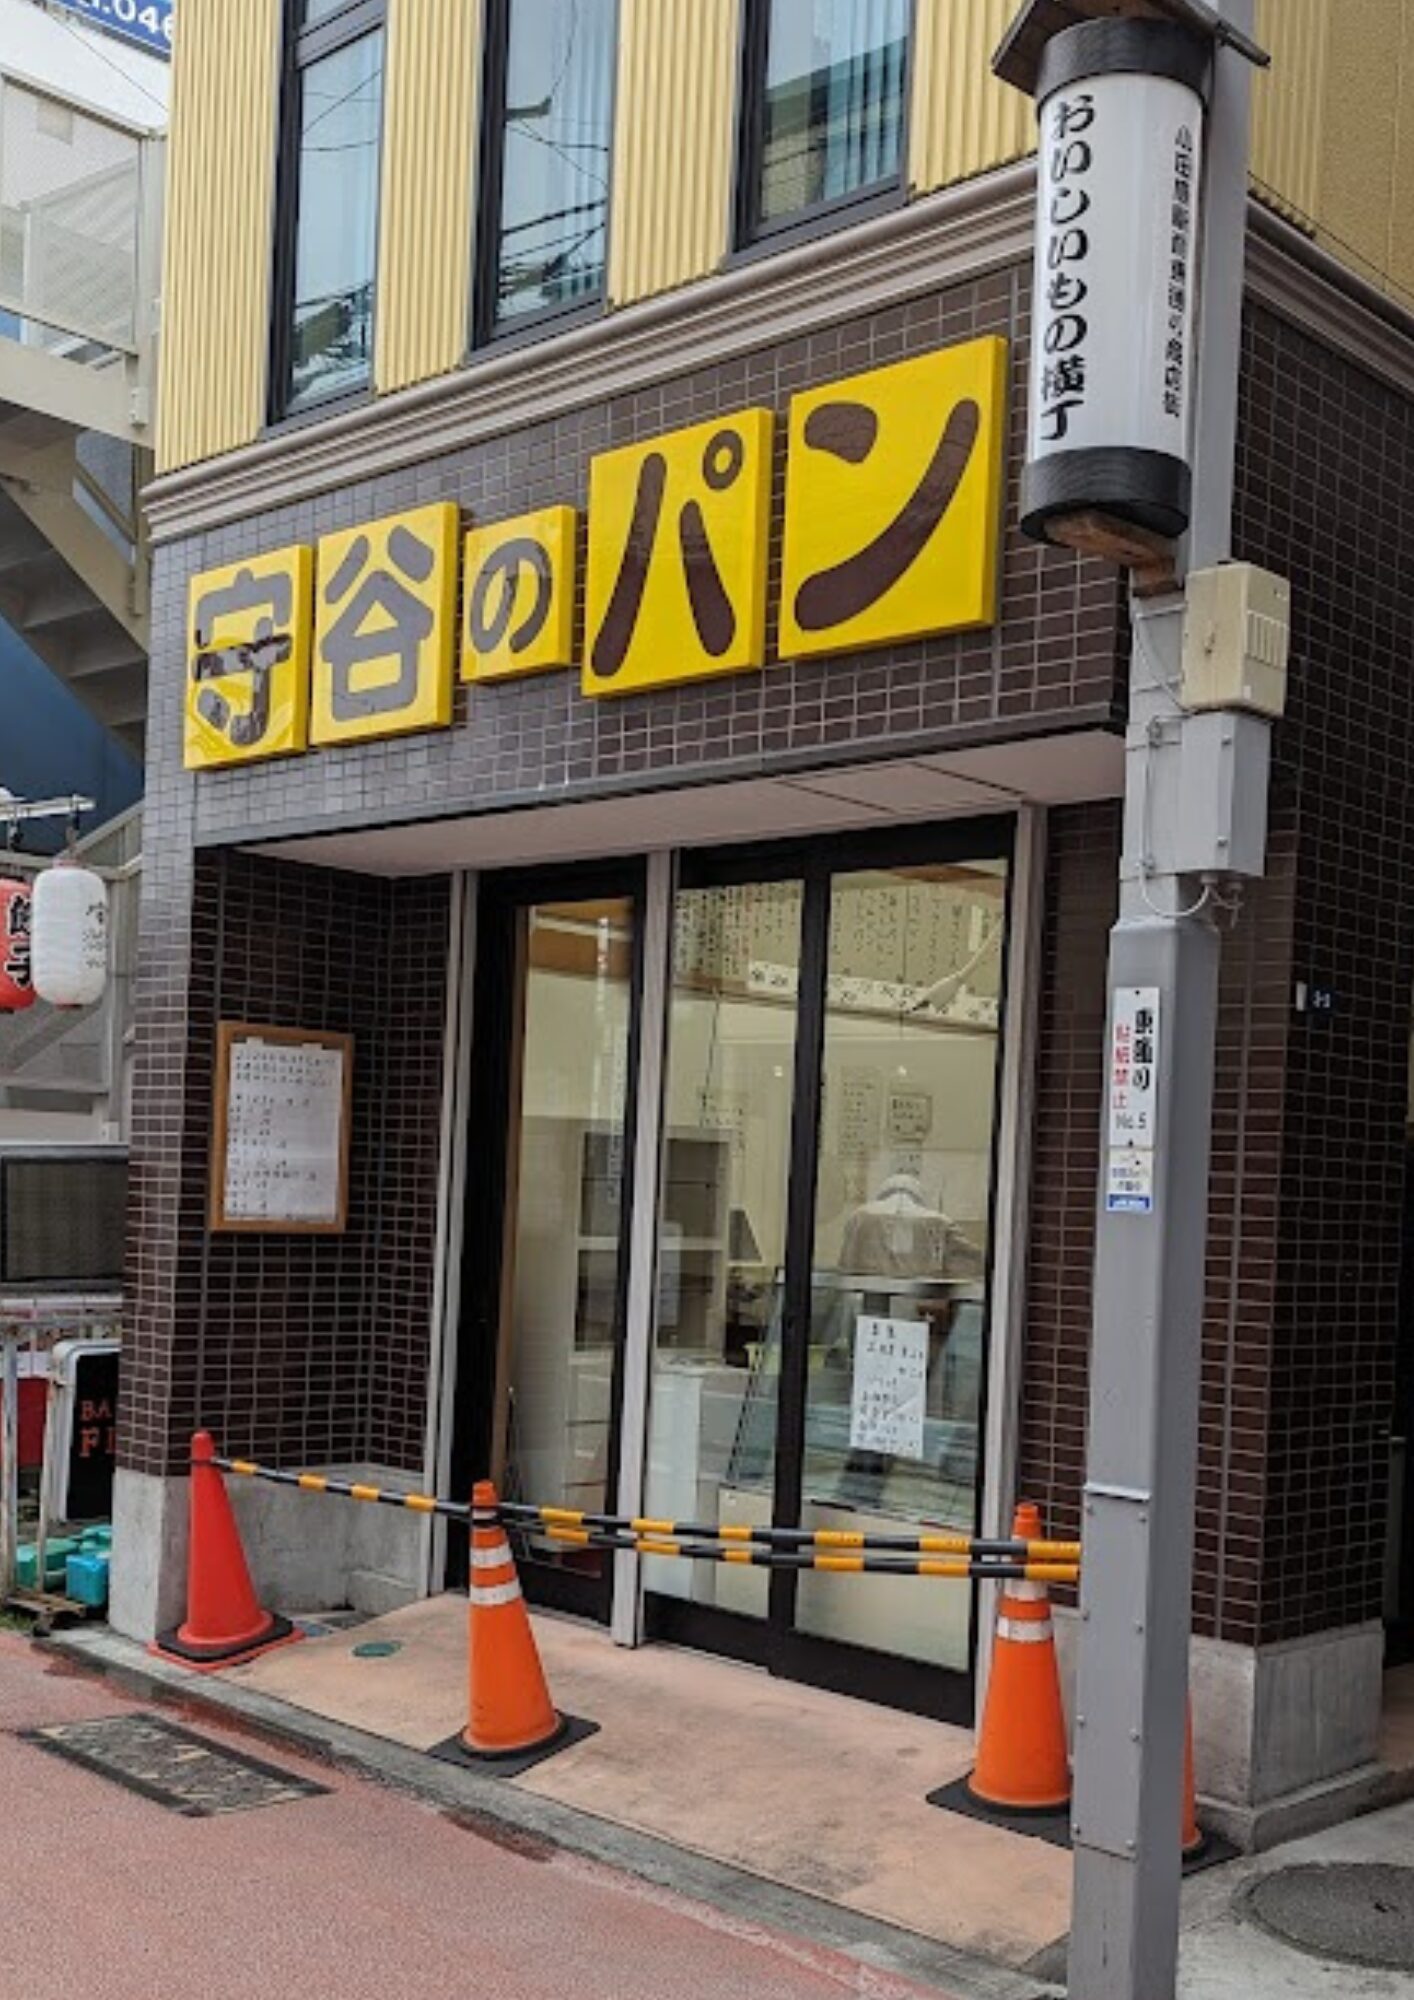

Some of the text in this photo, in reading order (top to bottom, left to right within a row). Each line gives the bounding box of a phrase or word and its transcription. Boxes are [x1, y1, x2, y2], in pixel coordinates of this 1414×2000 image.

[1040, 94, 1096, 441] おいしいもの横丁
[193, 399, 981, 746] 守谷のパン
